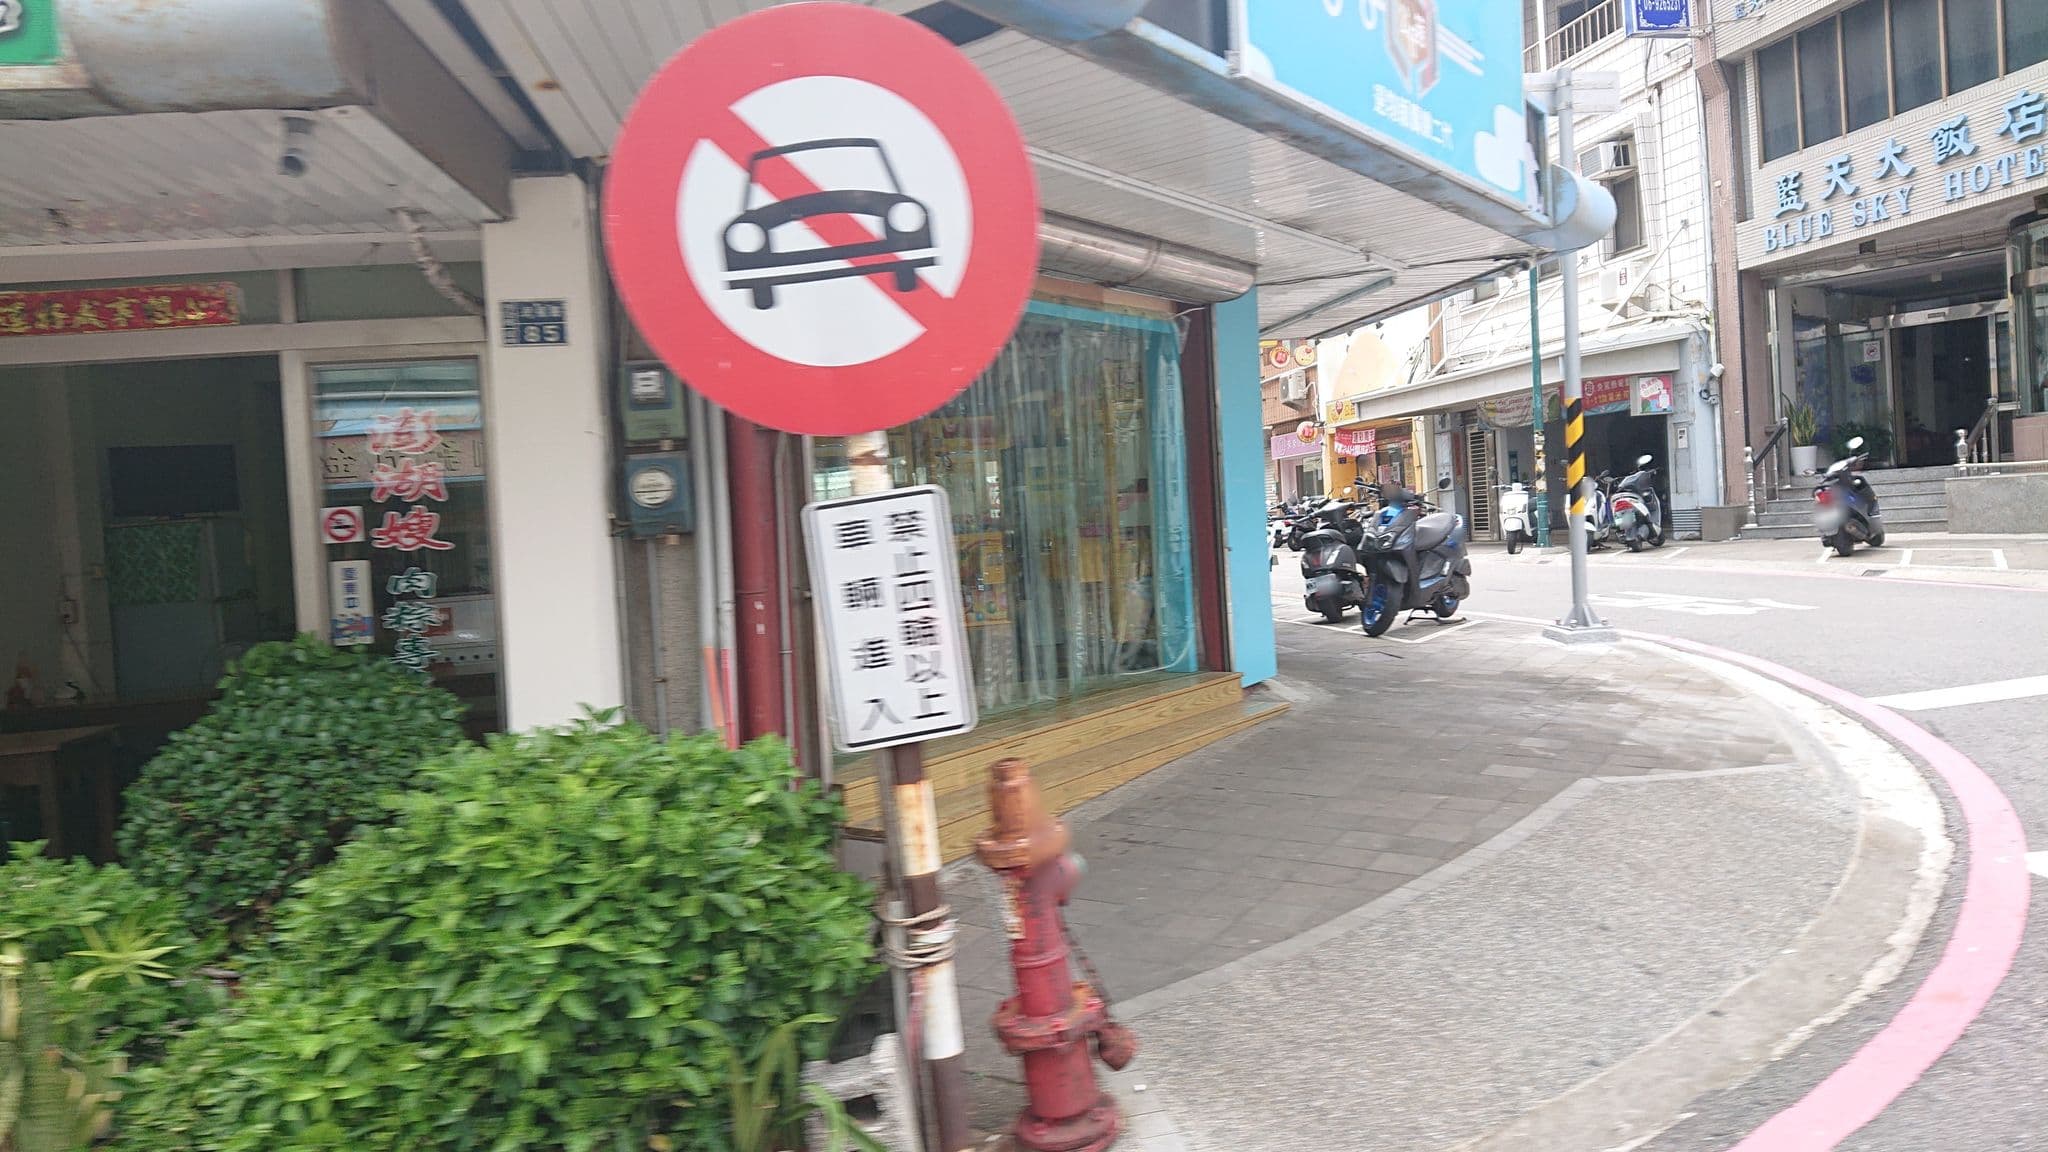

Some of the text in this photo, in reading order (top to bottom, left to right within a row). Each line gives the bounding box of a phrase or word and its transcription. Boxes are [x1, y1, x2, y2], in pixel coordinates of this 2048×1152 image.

[1763, 144, 2046, 253] BLUE SKY HOTE
[1774, 89, 2048, 219] 藍天大飯店
[365, 406, 456, 551] 澎湖嫂
[381, 566, 446, 673] 肉粽專
[832, 517, 904, 731] 車輛進入
[884, 510, 951, 720] 禁止四輪以上
